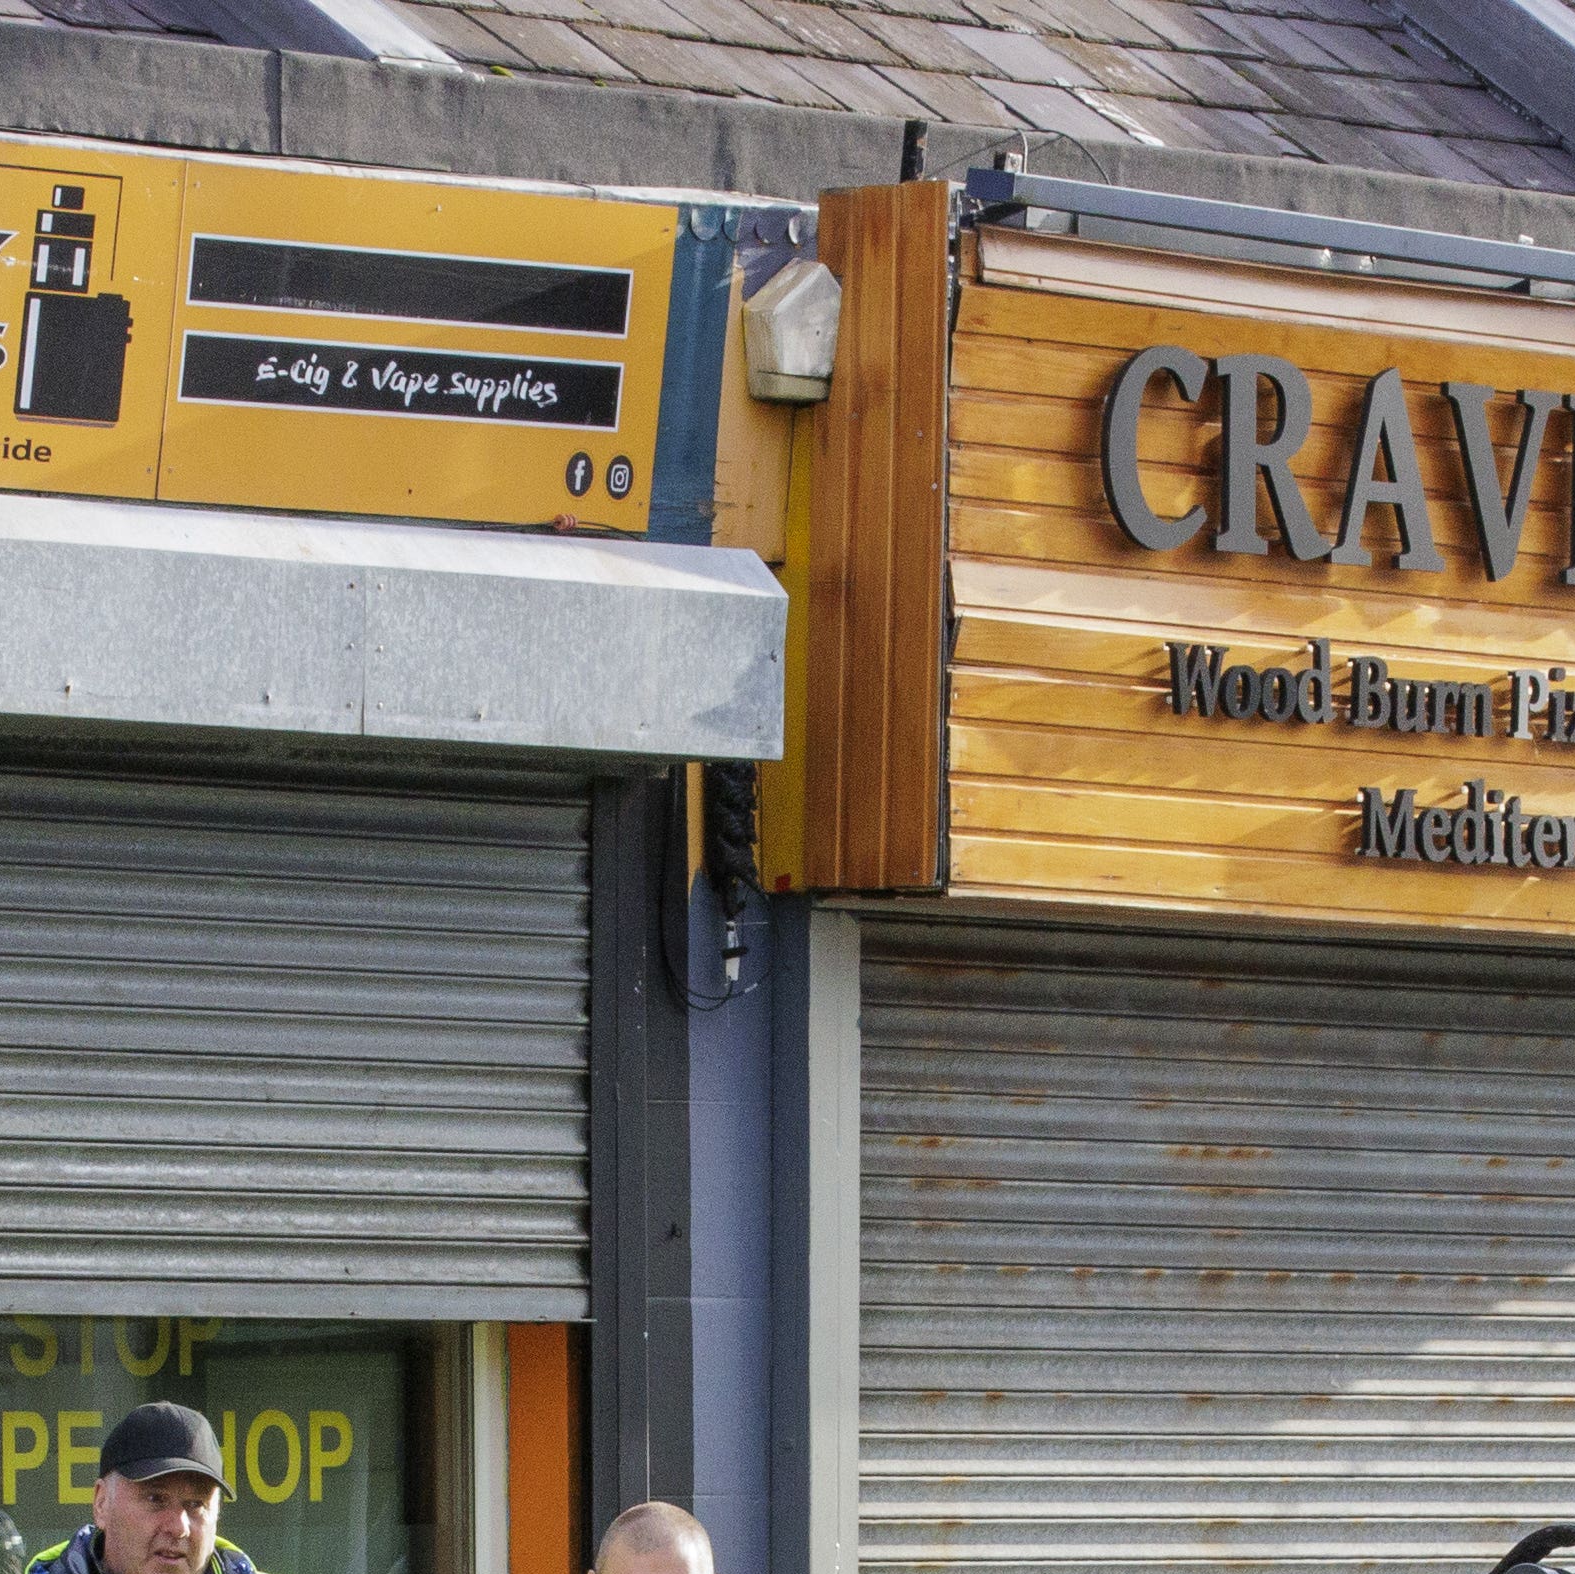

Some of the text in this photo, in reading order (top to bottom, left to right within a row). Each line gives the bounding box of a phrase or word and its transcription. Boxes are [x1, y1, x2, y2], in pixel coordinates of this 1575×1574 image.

[373, 361, 437, 406] Vape
[1165, 639, 1334, 724] Wood
[1350, 656, 1493, 738] Burn
